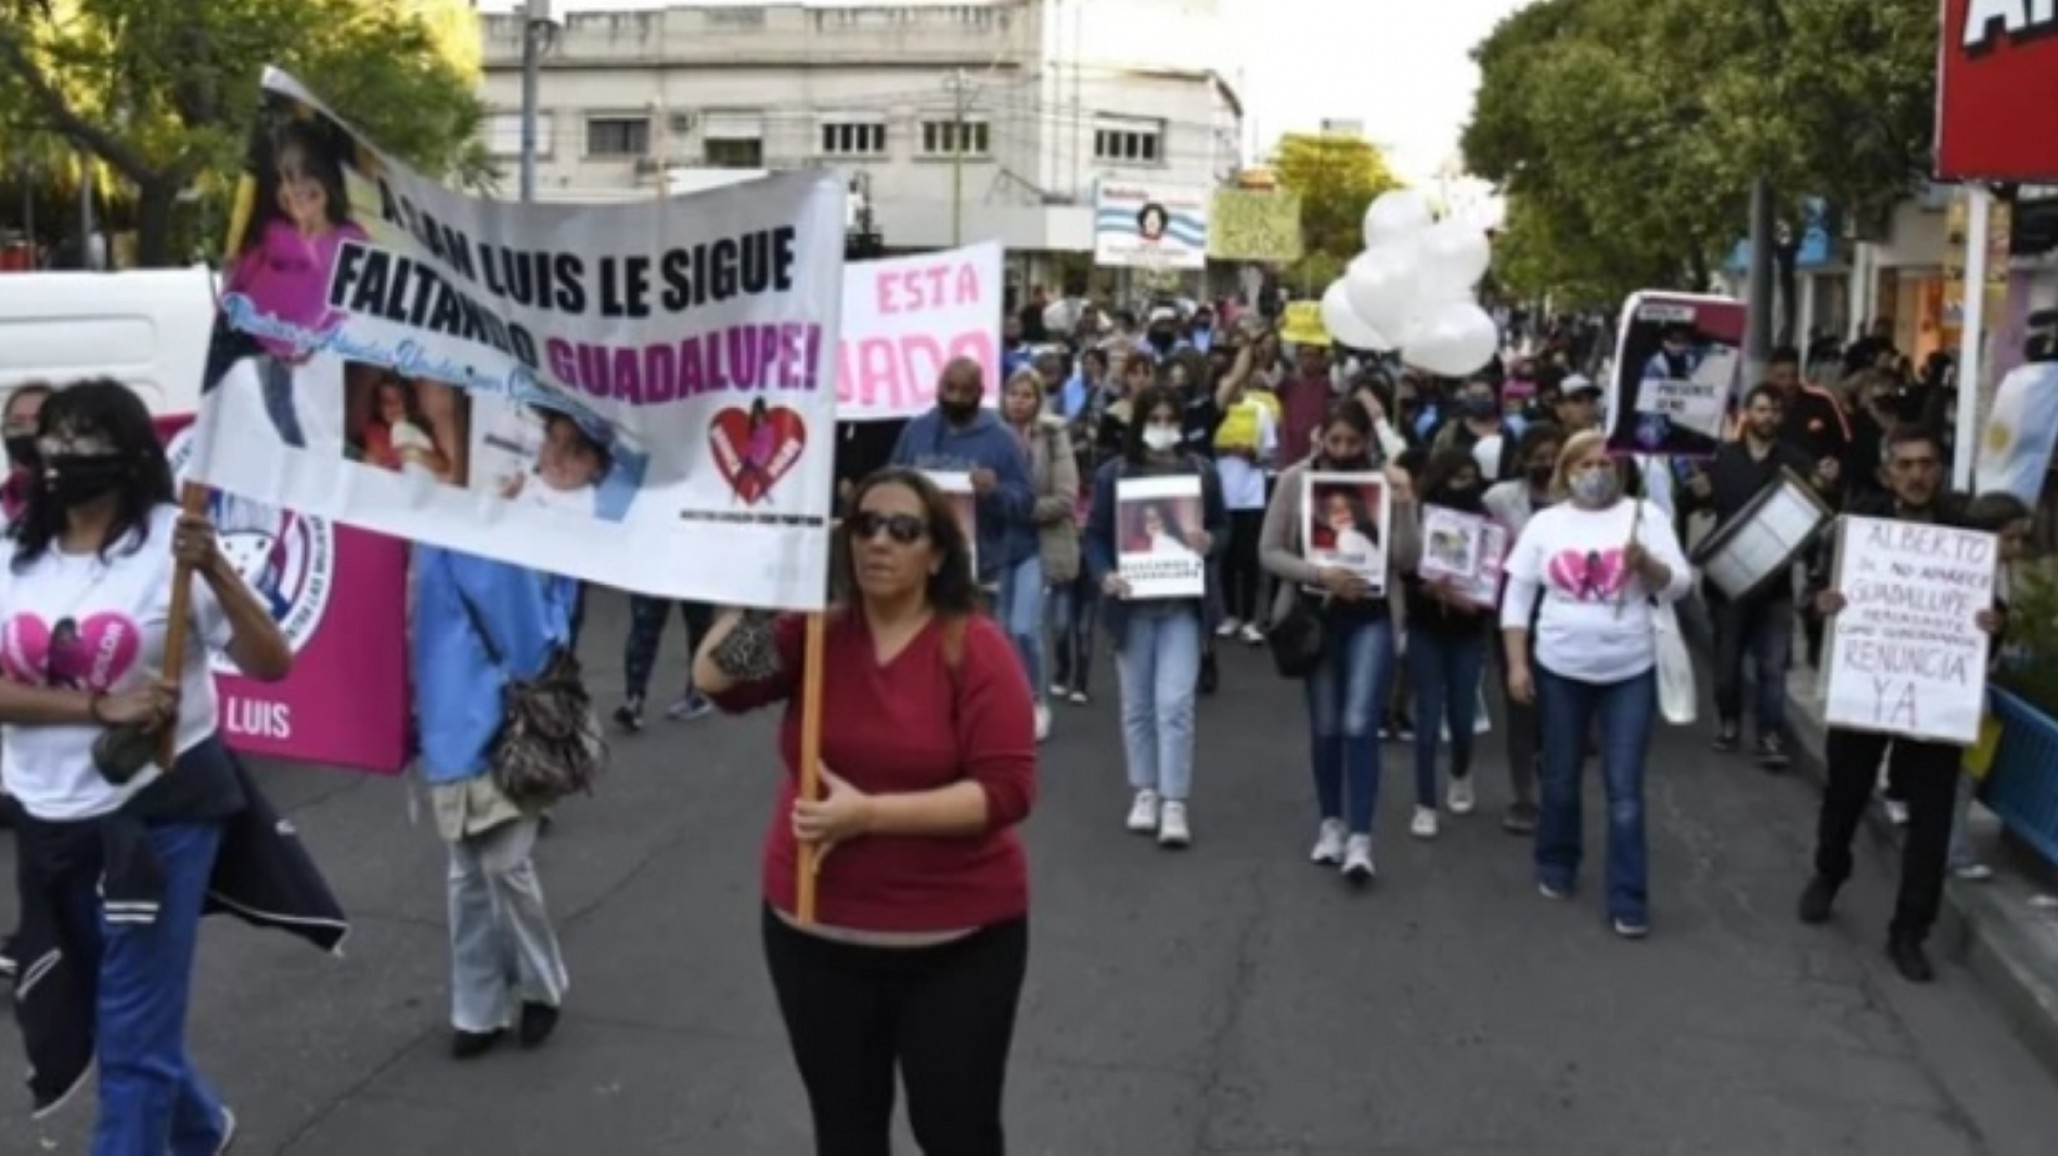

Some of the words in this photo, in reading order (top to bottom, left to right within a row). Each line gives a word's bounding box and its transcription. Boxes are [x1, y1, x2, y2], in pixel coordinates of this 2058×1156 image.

[478, 242, 586, 315] LUIS
[600, 255, 651, 318] LE
[660, 224, 796, 314] SIGUE
[877, 261, 980, 315] ESTA
[329, 241, 539, 370] FALTANDO
[545, 322, 821, 405] GUADALUPE!
[1866, 523, 1988, 563] ALBERTO
[1891, 562, 1915, 577] NO
[1852, 578, 1971, 617] GUADALUPE
[1845, 640, 1974, 684] RENUNCIA
[228, 696, 291, 738] LUIS
[1873, 676, 1918, 729] YA
